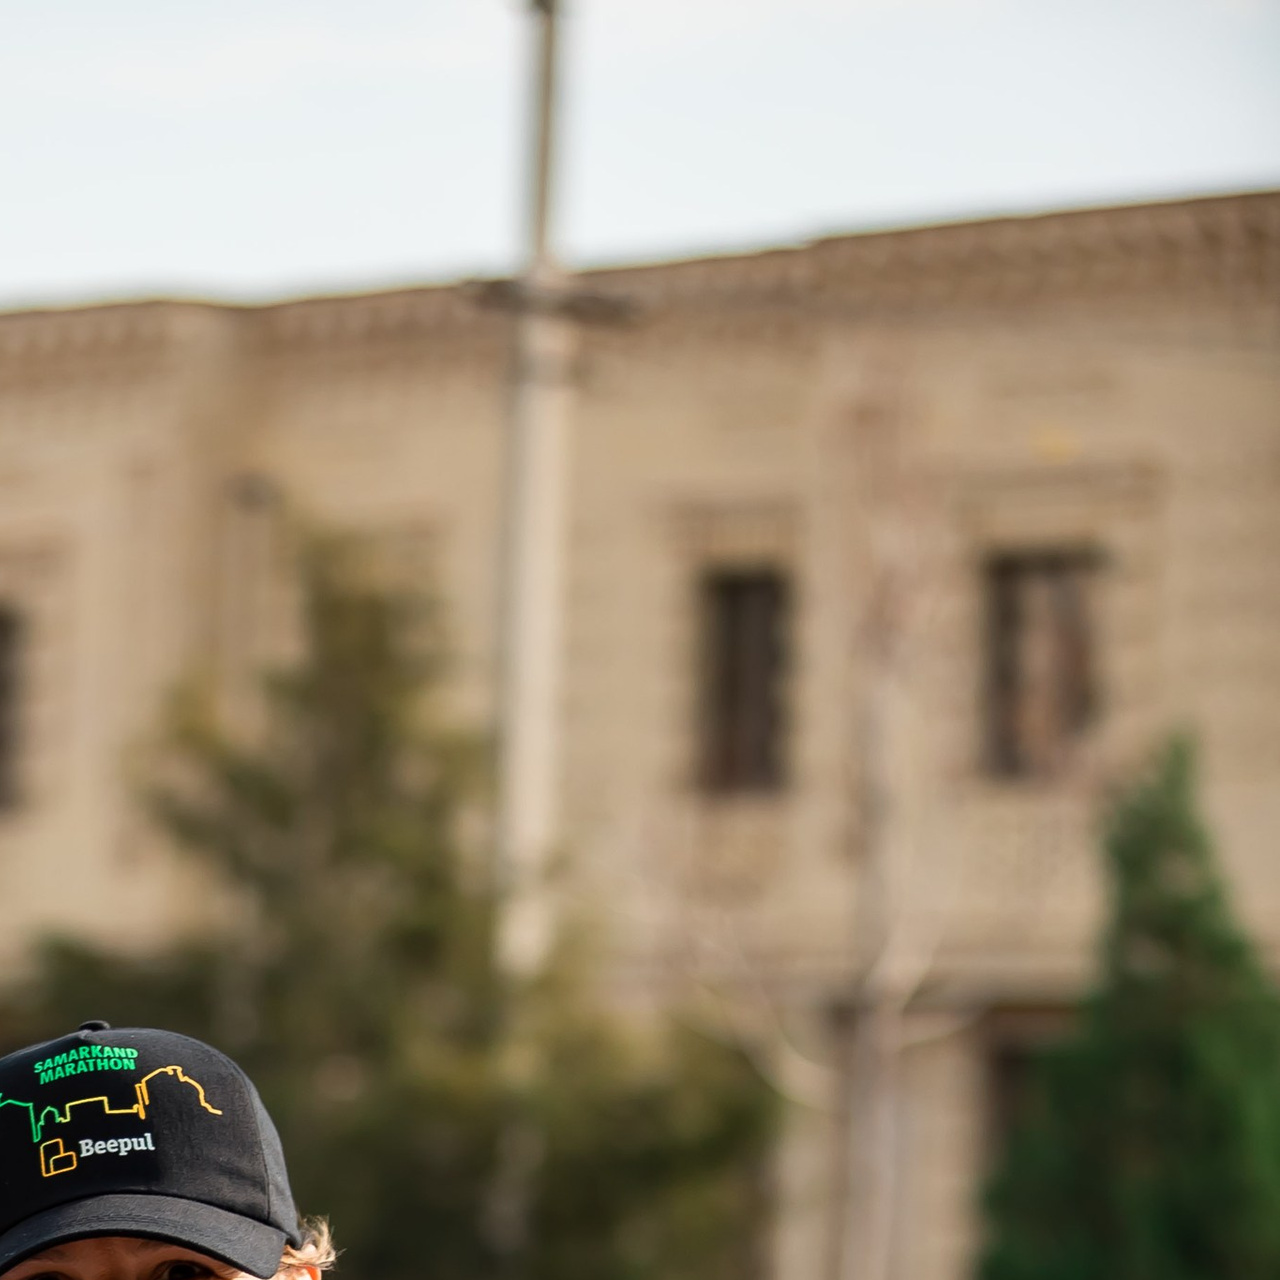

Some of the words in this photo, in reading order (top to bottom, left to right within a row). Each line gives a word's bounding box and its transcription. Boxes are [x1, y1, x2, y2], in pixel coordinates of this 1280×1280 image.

[34, 1045, 138, 1073] SAMARKAND
[40, 1058, 136, 1085] MARATHON
[79, 1133, 156, 1158] Beepul
